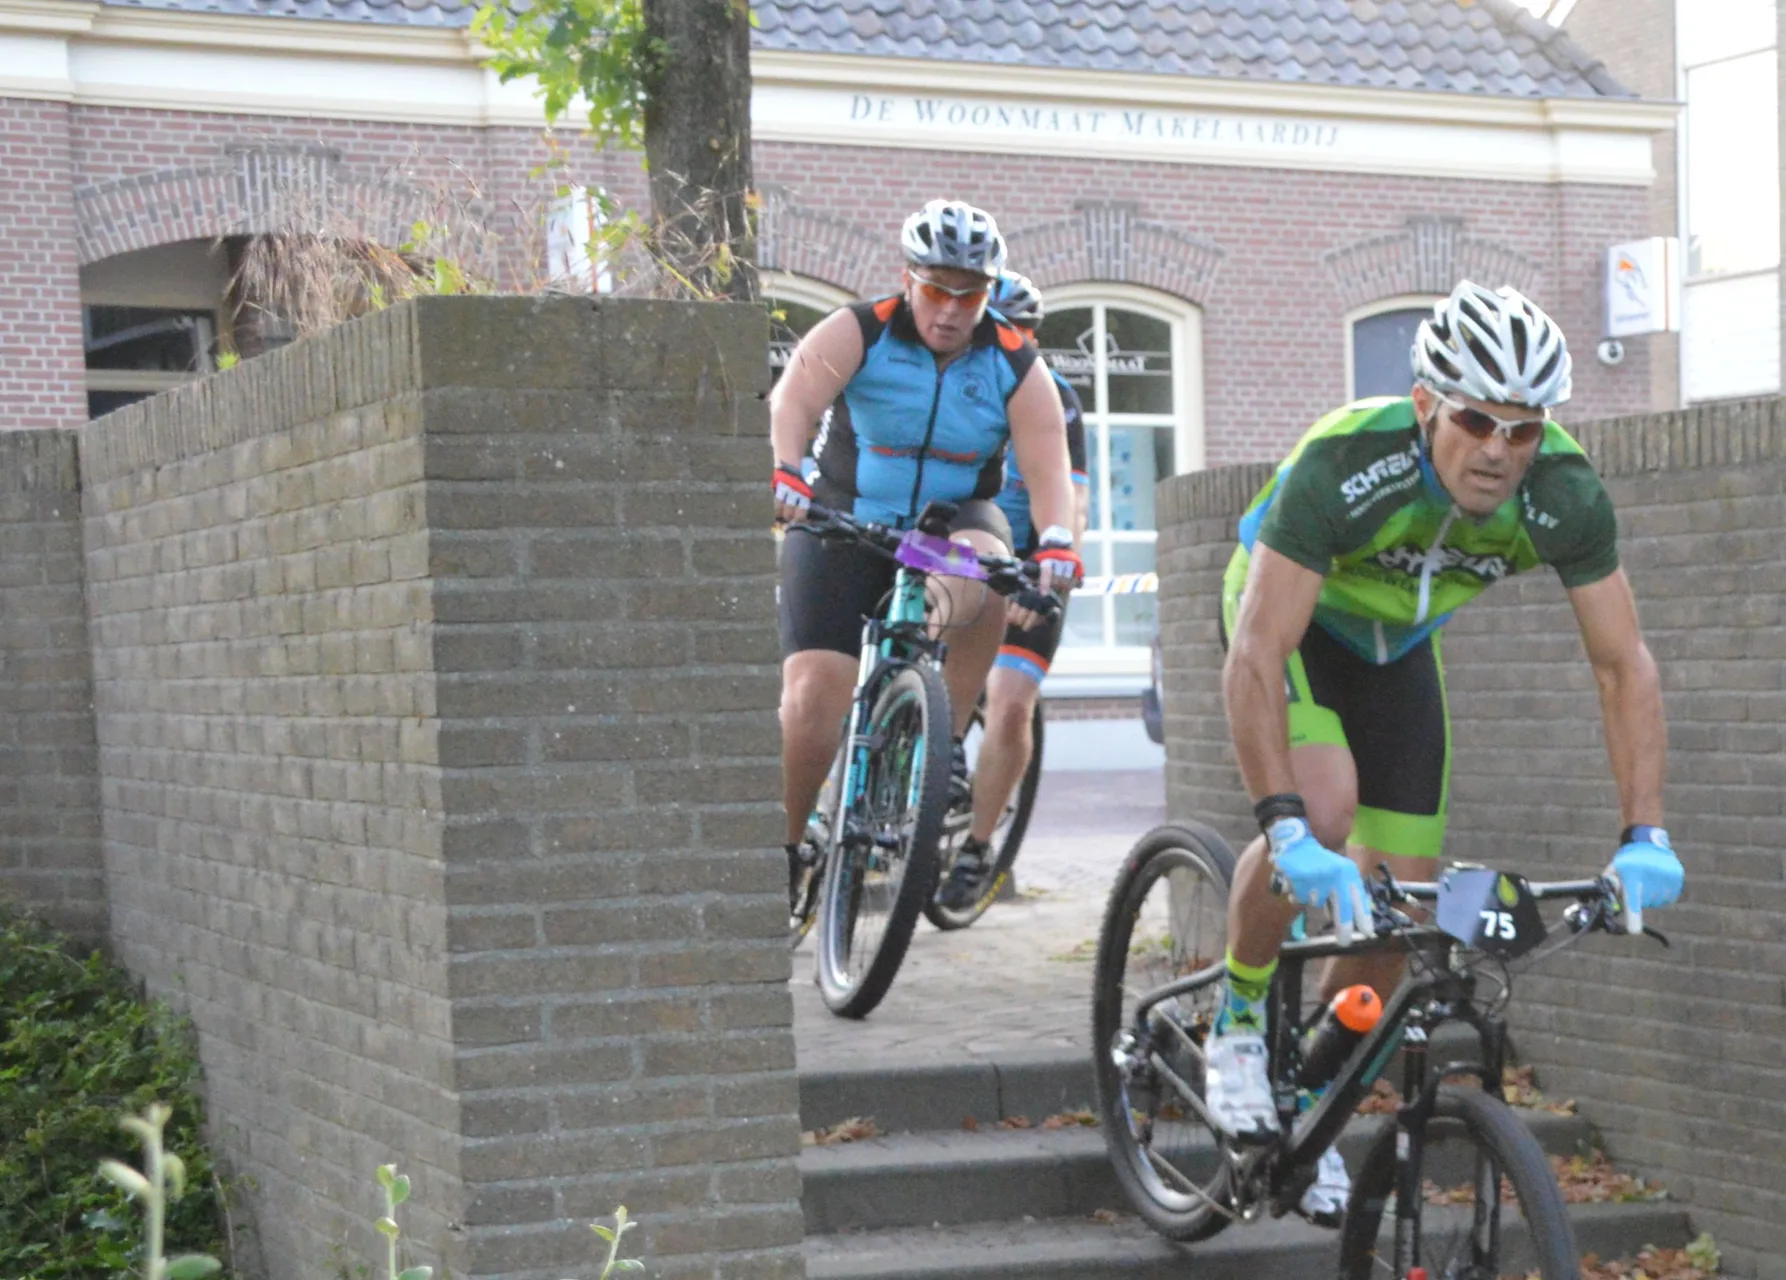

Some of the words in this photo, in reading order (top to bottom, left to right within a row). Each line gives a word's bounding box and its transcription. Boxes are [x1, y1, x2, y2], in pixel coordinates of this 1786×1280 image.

[915, 98, 1106, 132] WOONMAAT
[1119, 111, 1338, 147] MAKELAARDIJ
[1480, 911, 1516, 940] 75
